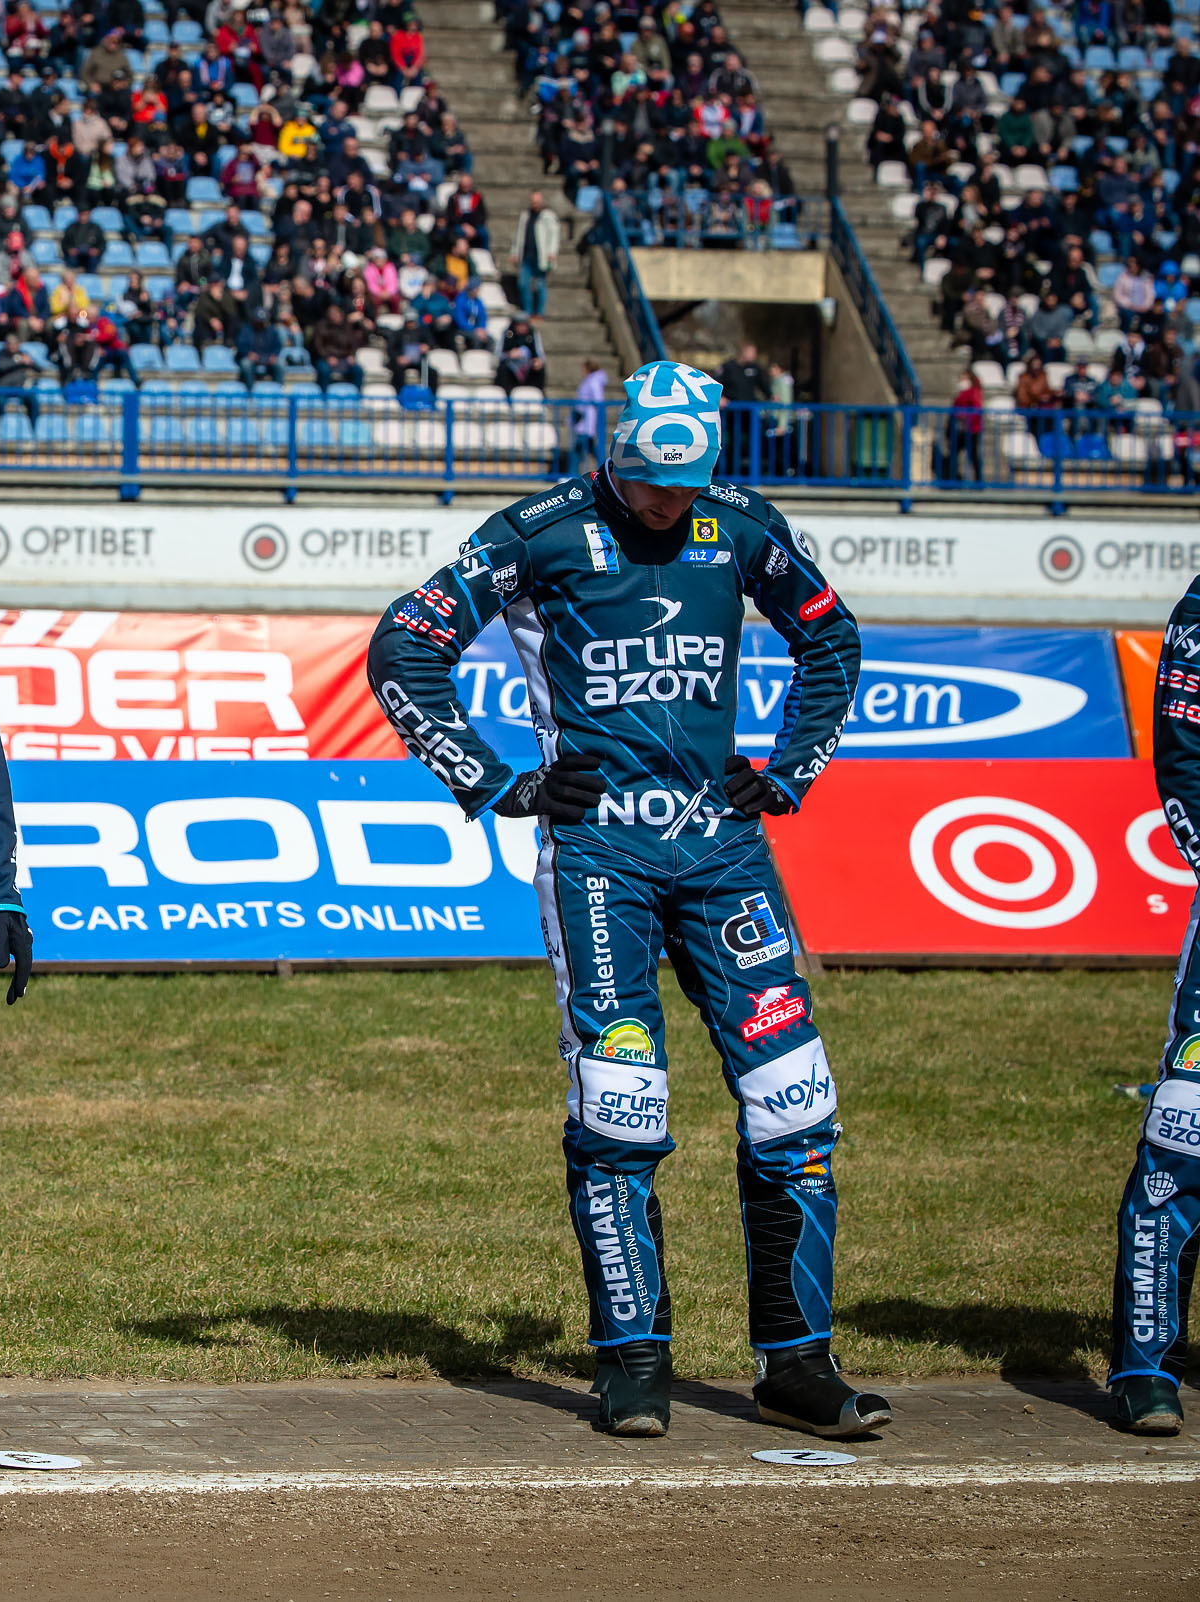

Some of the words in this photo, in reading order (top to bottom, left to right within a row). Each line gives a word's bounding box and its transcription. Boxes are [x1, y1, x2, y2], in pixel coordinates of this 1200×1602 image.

[519, 494, 564, 520] CHEMART
[20, 524, 155, 557] OPTIBET
[300, 527, 433, 559] OPTIBET
[829, 534, 959, 567] OPTIBET
[51, 904, 148, 931] CAR
[158, 901, 306, 931] PARTS
[316, 903, 486, 932] ONLINE
[586, 876, 620, 1012] Saletromag
[738, 948, 768, 968] dasta
[586, 1180, 637, 1322] CHEMART
[1159, 1214, 1170, 1259] TRADER
[622, 1221, 652, 1317] INTERNATIONAL
[1132, 1213, 1156, 1343] CHEMART
[1158, 1260, 1169, 1343] INTERNATIONAL
